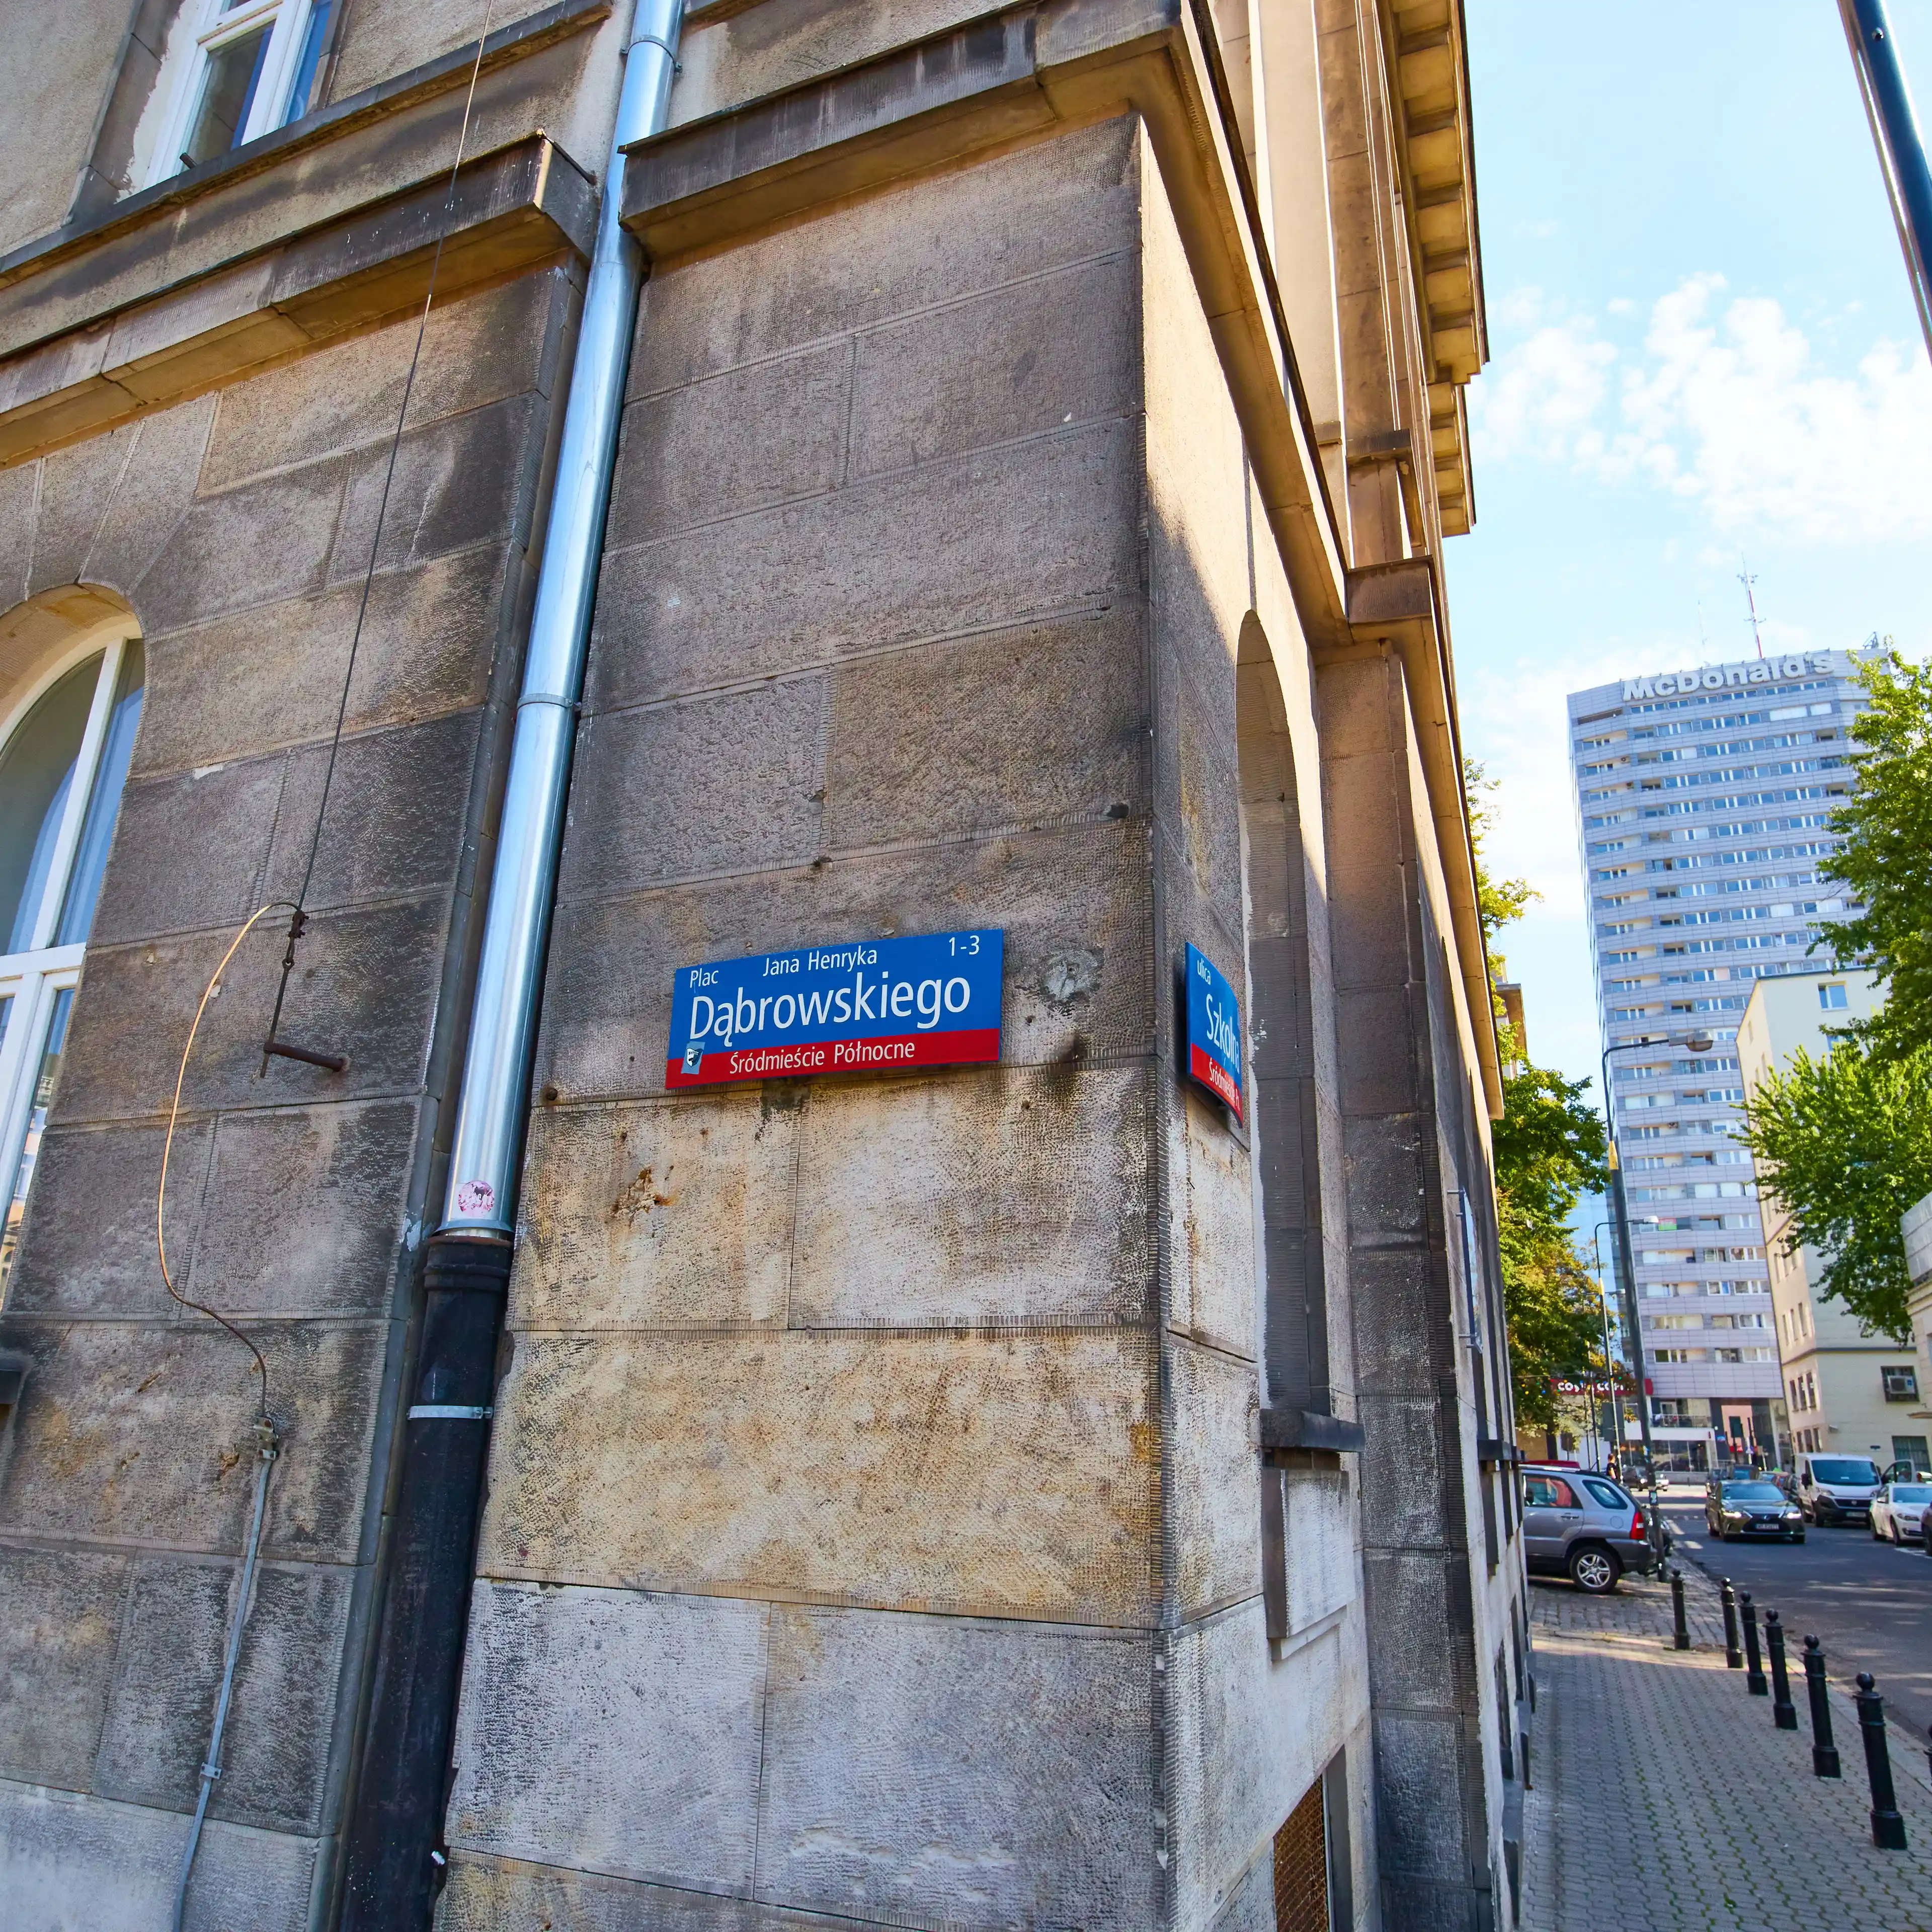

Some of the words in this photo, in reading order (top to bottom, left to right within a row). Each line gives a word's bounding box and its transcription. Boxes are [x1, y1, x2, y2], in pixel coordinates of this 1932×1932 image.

[1623, 654, 1835, 701] McDonald's
[763, 957, 799, 977] Jana
[808, 945, 877, 972] Henryka
[948, 935, 980, 956] 1-3
[690, 968, 719, 988] Plac
[1196, 958, 1211, 986] ulica
[689, 972, 971, 1048] Dąbrowskiego
[1205, 994, 1240, 1075] Szkolna
[730, 1046, 825, 1074] Śródmieście
[834, 1040, 916, 1064] Północne
